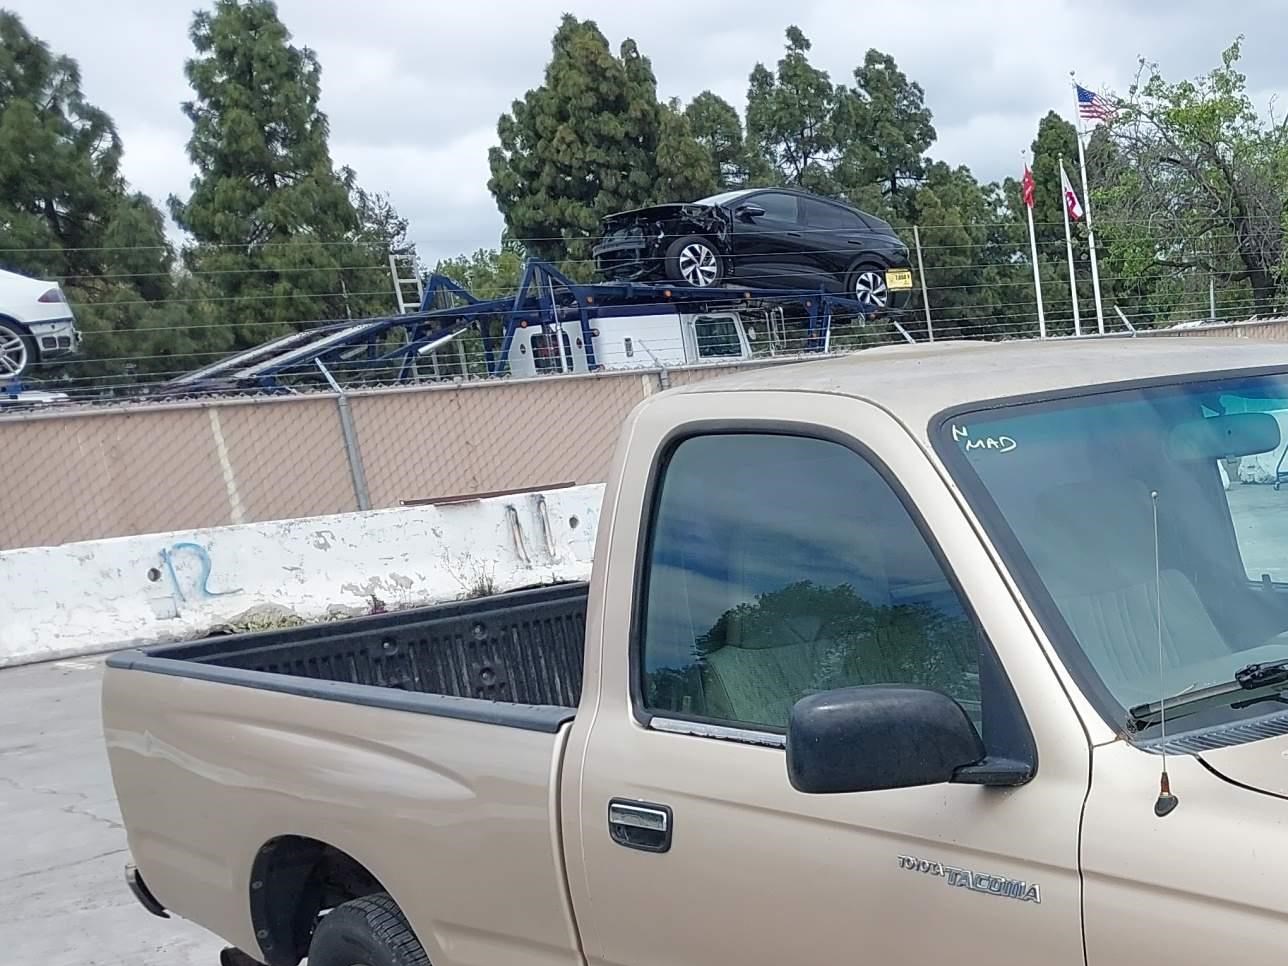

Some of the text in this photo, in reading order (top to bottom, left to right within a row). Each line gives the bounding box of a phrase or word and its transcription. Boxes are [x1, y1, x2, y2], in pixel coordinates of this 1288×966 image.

[951, 424, 969, 442] N
[965, 436, 1017, 453] MAD
[897, 855, 1041, 903] TOYOTA TACOMA
